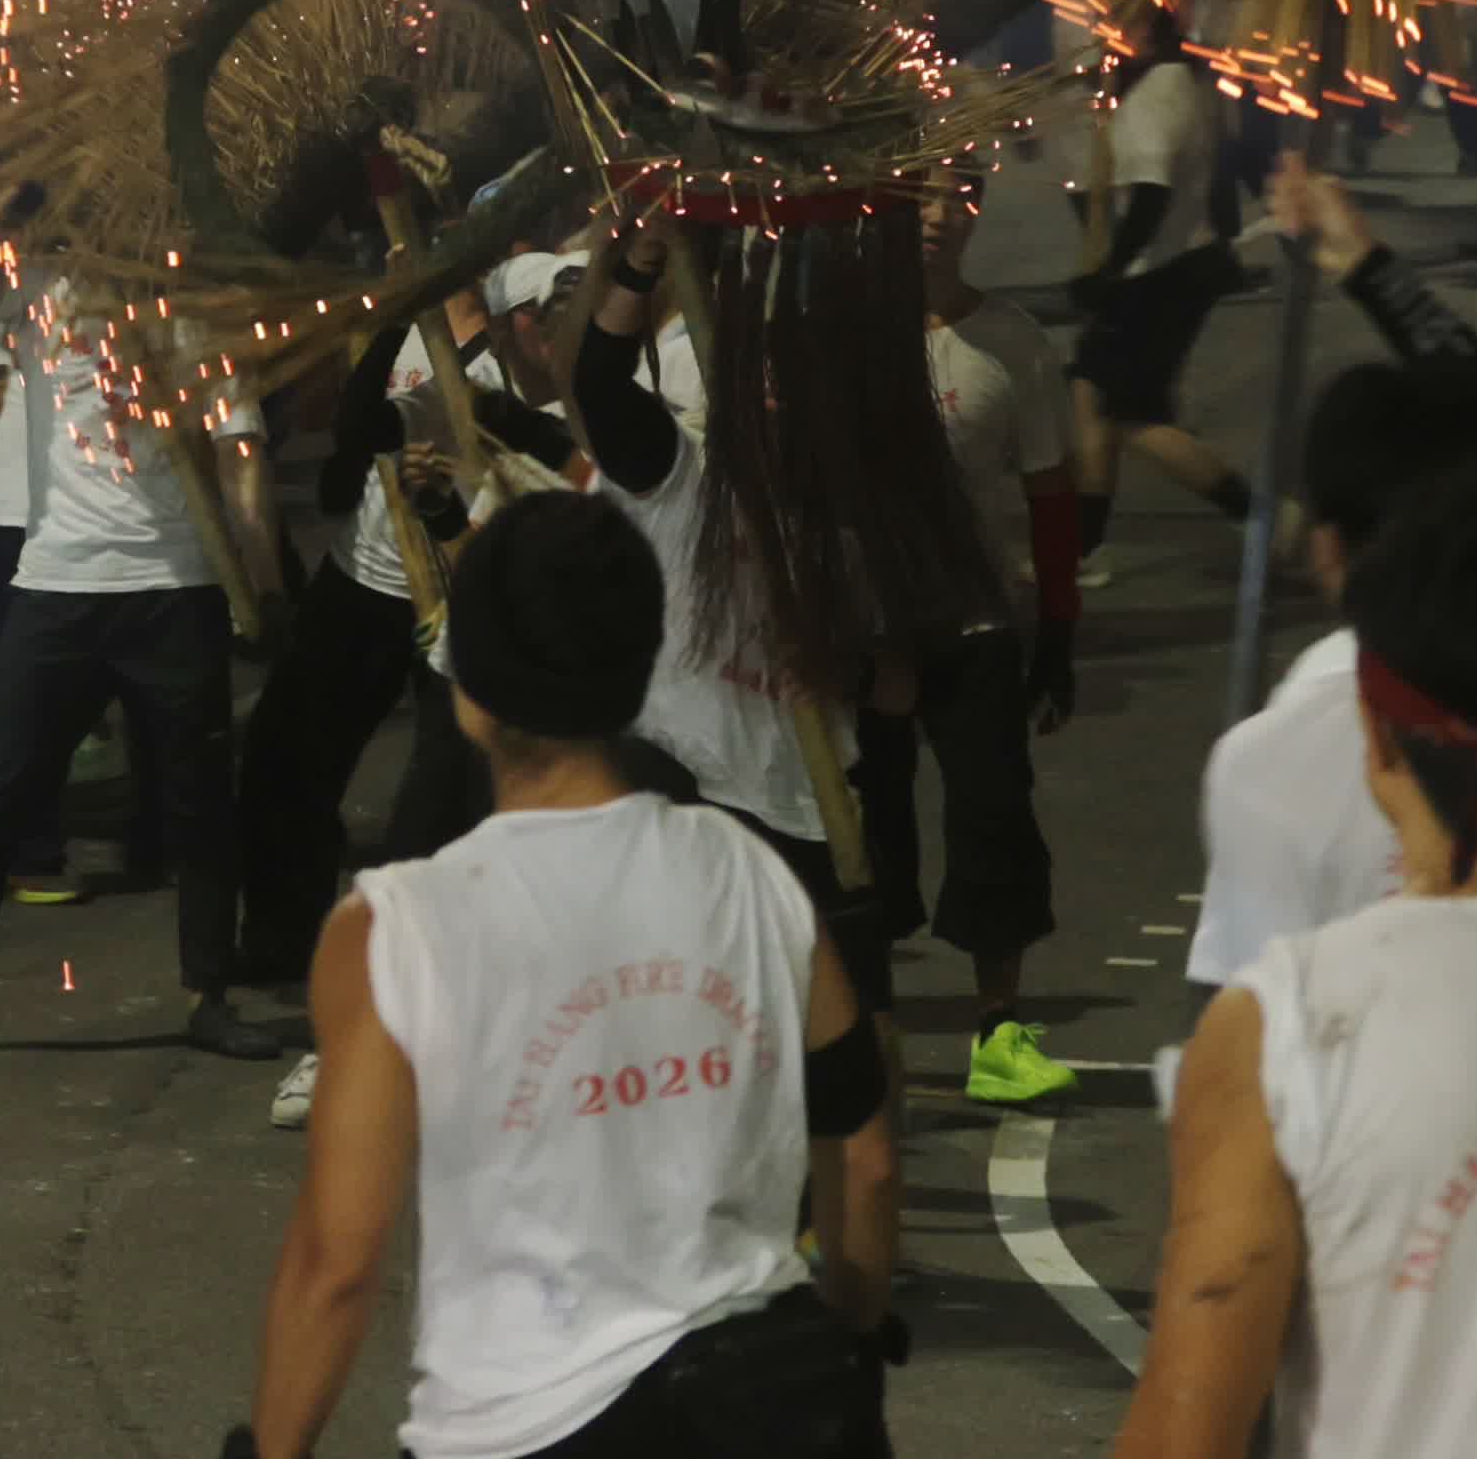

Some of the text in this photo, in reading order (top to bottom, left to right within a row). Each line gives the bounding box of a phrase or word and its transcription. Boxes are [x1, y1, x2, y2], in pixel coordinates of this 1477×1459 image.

[521, 973, 611, 1069] HANG
[615, 958, 684, 1001] FIRE
[572, 1043, 734, 1117] 2026
[1388, 1222, 1451, 1293] TAI
